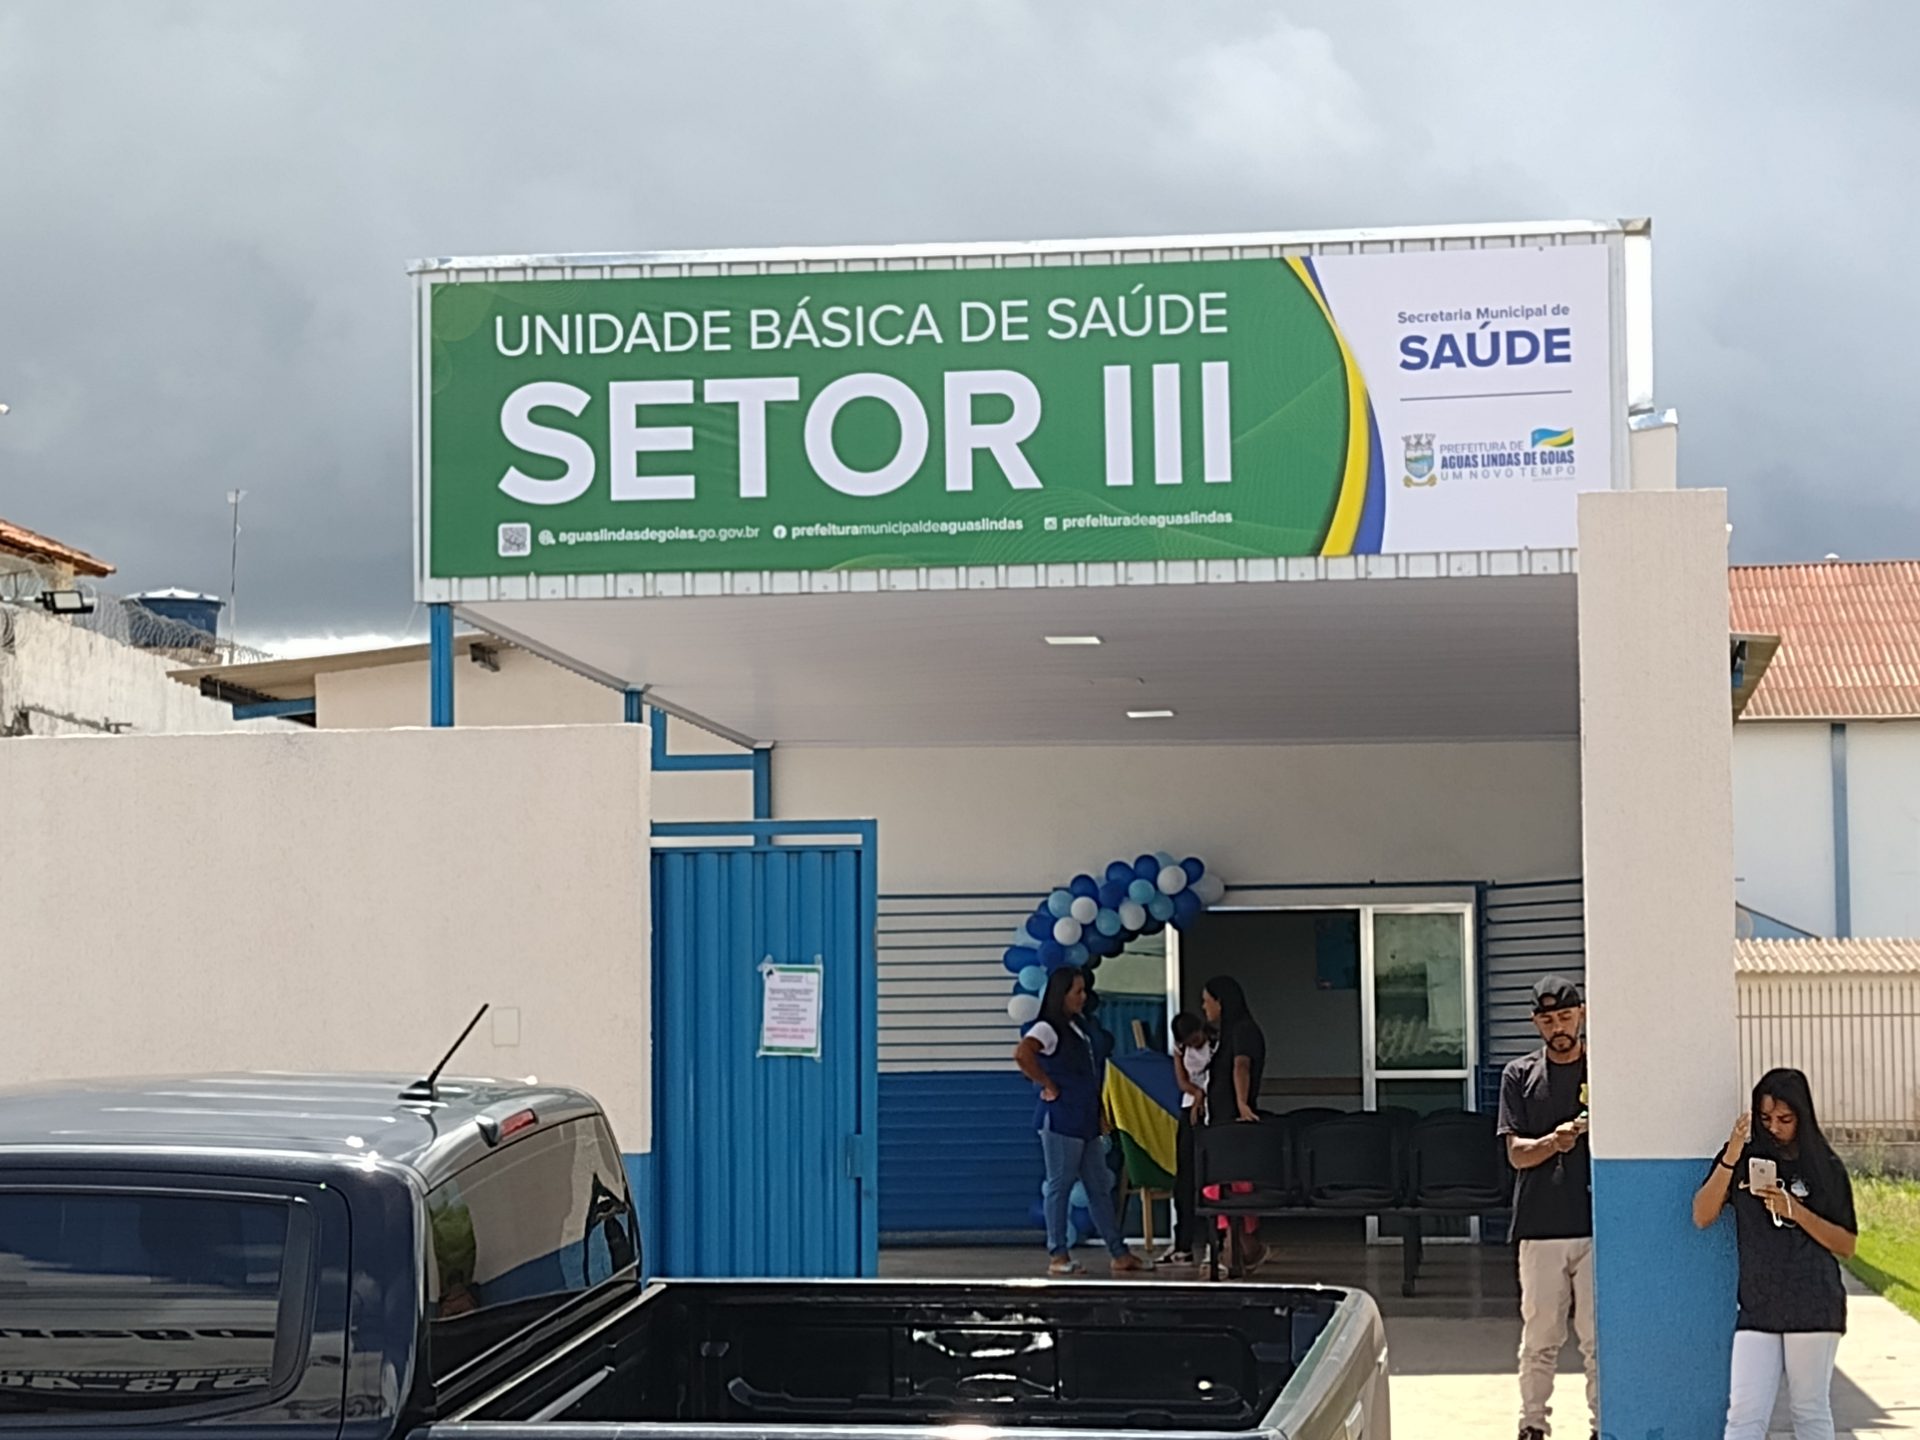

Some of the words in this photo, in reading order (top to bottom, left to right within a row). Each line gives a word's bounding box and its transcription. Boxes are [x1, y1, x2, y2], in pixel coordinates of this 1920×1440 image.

[494, 311, 732, 357] UNIDADE
[749, 295, 943, 350] BÁSICA
[960, 299, 1030, 343] DE
[1046, 283, 1228, 339] SAÚDE
[1397, 308, 1472, 324] Secretaria
[1476, 304, 1547, 320] Municipal
[1551, 303, 1570, 316] de
[1399, 320, 1572, 371] SAÚDE
[497, 371, 1044, 505] SETOR
[1104, 360, 1232, 487] III
[1439, 442, 1507, 454] PREFEITURA
[1510, 440, 1525, 451] DE
[1481, 452, 1521, 468] LINDAS
[1523, 451, 1538, 466] DE
[791, 517, 1024, 540] prefeituramunicipaldeaguaslindas
[1062, 511, 1232, 531] prefeituradeaguaslindas
[558, 525, 760, 545] aguaslindasdegoias.go.gov.br
